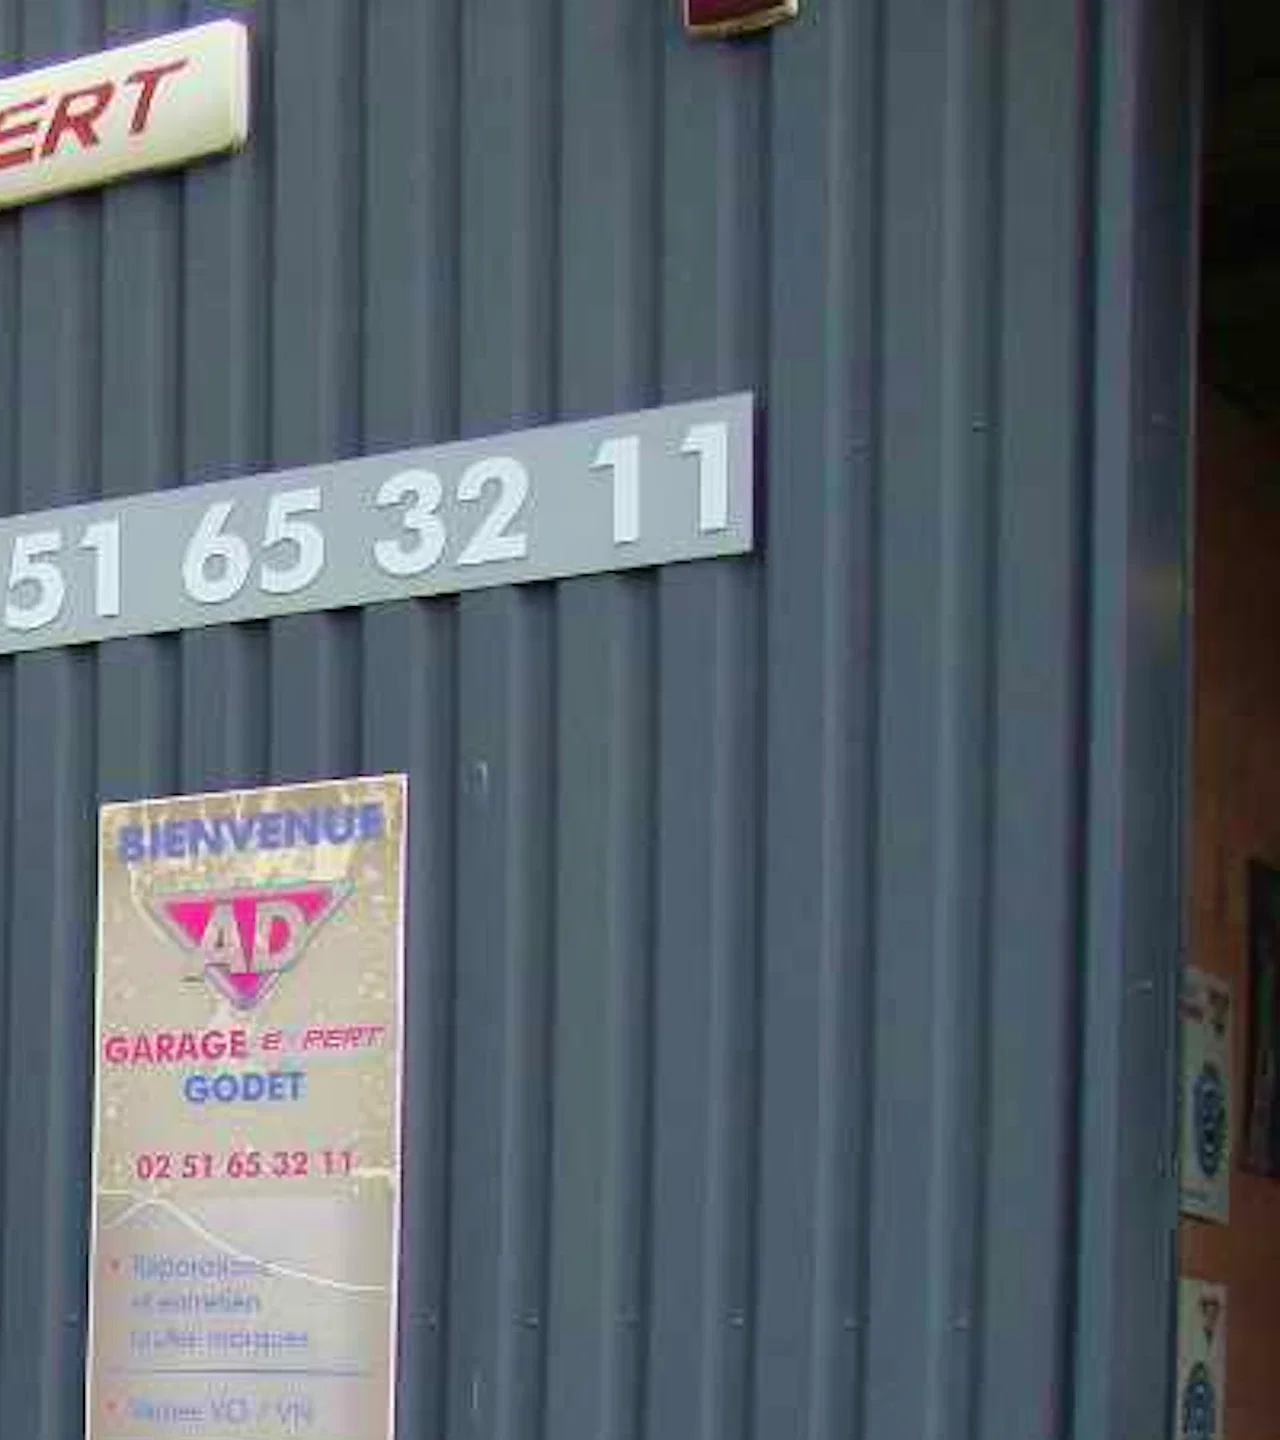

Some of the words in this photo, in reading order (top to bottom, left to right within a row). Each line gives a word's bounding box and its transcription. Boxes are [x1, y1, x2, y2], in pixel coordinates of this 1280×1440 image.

[3, 519, 121, 632] 51
[180, 486, 328, 604] 65
[370, 455, 530, 577] 32
[588, 421, 731, 544] 11
[117, 803, 385, 864] BIENVENUE
[202, 900, 306, 976] AD
[104, 1029, 249, 1064] GARAGE
[184, 1071, 306, 1103] GODET
[136, 1155, 171, 1179] 02
[182, 1154, 213, 1179] 51
[226, 1152, 260, 1178] 65
[271, 1151, 309, 1178] 32
[322, 1151, 353, 1176] 11
